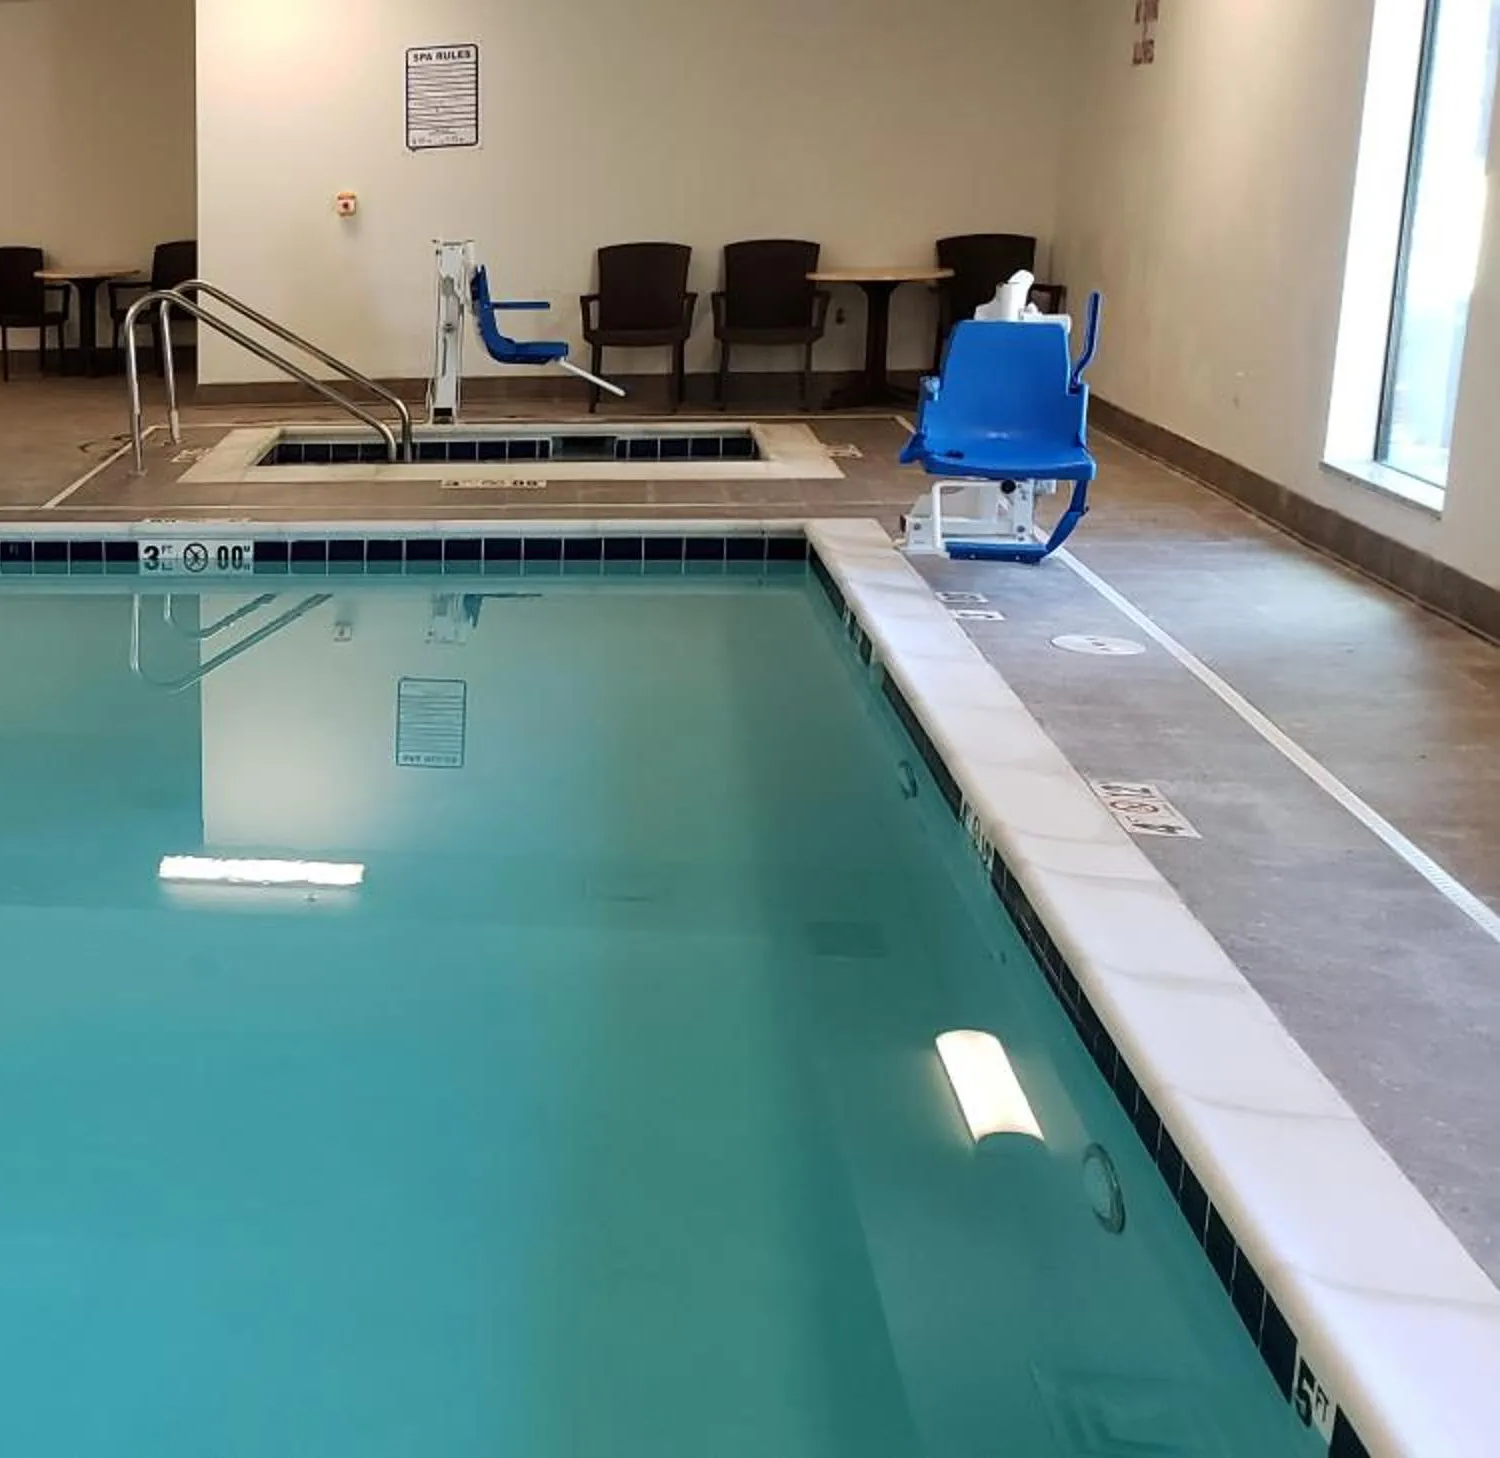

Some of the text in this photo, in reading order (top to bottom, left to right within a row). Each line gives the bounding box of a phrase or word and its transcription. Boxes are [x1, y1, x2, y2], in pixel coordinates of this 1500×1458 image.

[413, 50, 471, 62] SPA RULES
[143, 545, 160, 570] 3
[1297, 1356, 1315, 1428] 5
